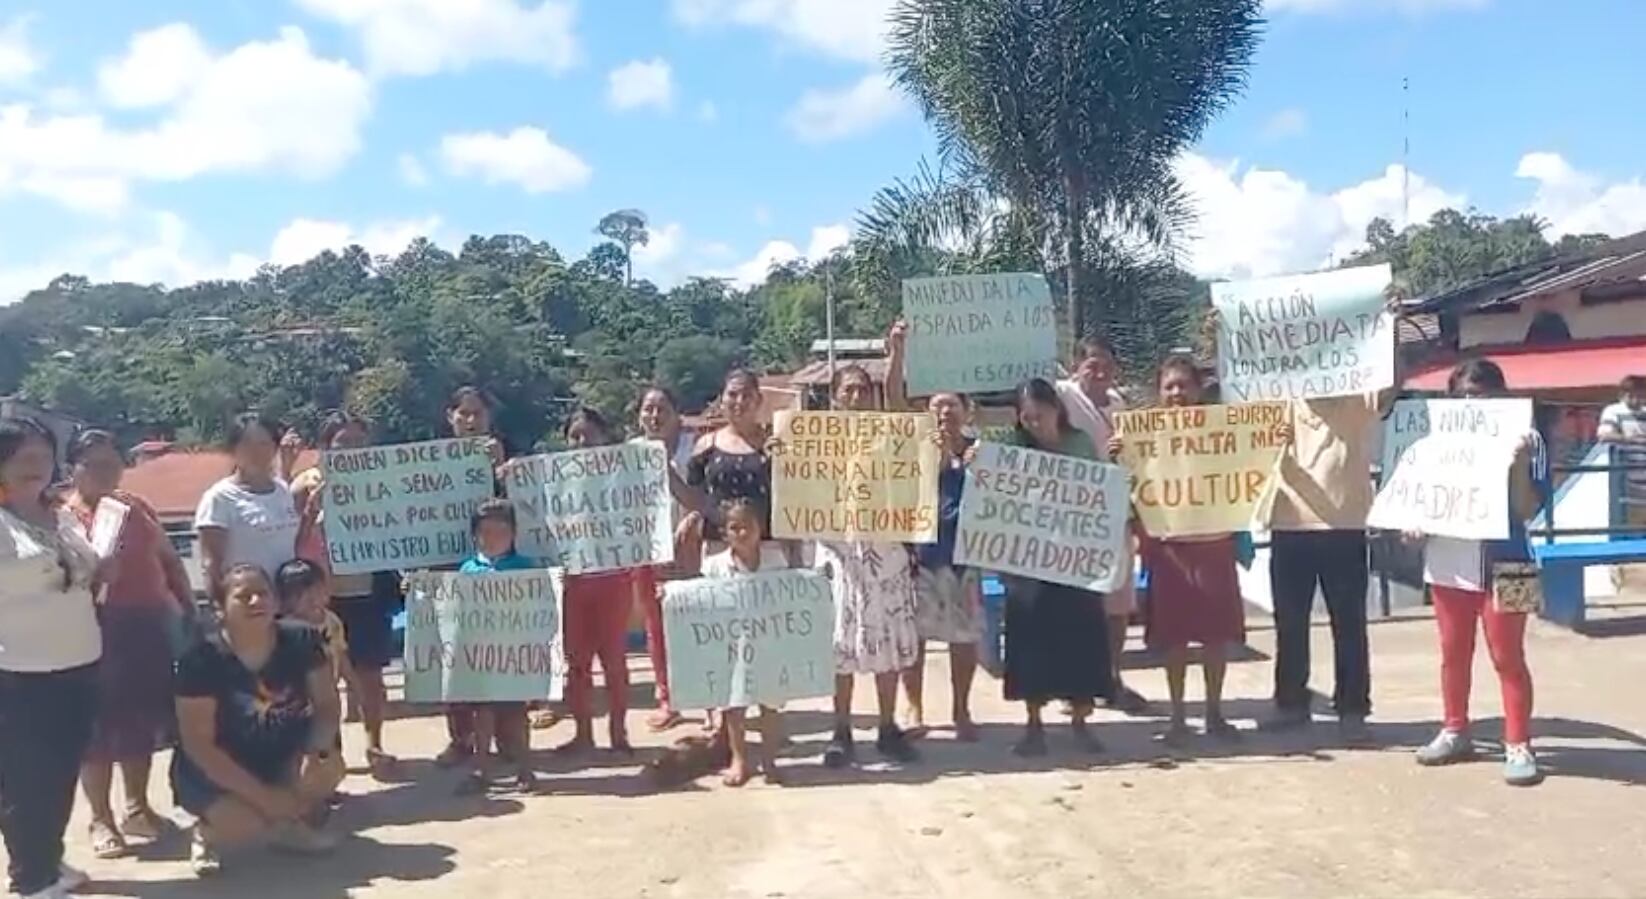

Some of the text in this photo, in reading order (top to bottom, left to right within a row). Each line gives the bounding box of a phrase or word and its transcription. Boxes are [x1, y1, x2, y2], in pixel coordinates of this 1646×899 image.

[906, 280, 974, 306] MINEDU
[1318, 347, 1359, 370] LOS
[790, 415, 916, 438] GOBIERNO
[1227, 405, 1284, 425] BURRO
[1394, 410, 1431, 433] LAS
[394, 445, 441, 464] DICE
[892, 439, 906, 456] Y
[1134, 440, 1158, 458] TE
[512, 464, 538, 488] EN
[543, 458, 566, 485] LA
[571, 450, 629, 479] SELVA
[784, 460, 922, 480] NORMALIZA
[996, 447, 1107, 484] MINEDU
[331, 467, 487, 506] EN LA SELVA SE
[835, 484, 872, 502] LAS
[974, 468, 1107, 511] RESPALDA
[1138, 469, 1265, 507] CULTUR
[337, 511, 399, 531] VIOLA
[405, 505, 439, 526] POR
[622, 515, 657, 537] SON
[783, 505, 933, 532] VIOLACIONES
[974, 497, 1111, 540] DOCENTES
[962, 529, 1116, 580] VIOLADORES
[691, 609, 813, 646] DOCENTES
[728, 641, 755, 665] NO
